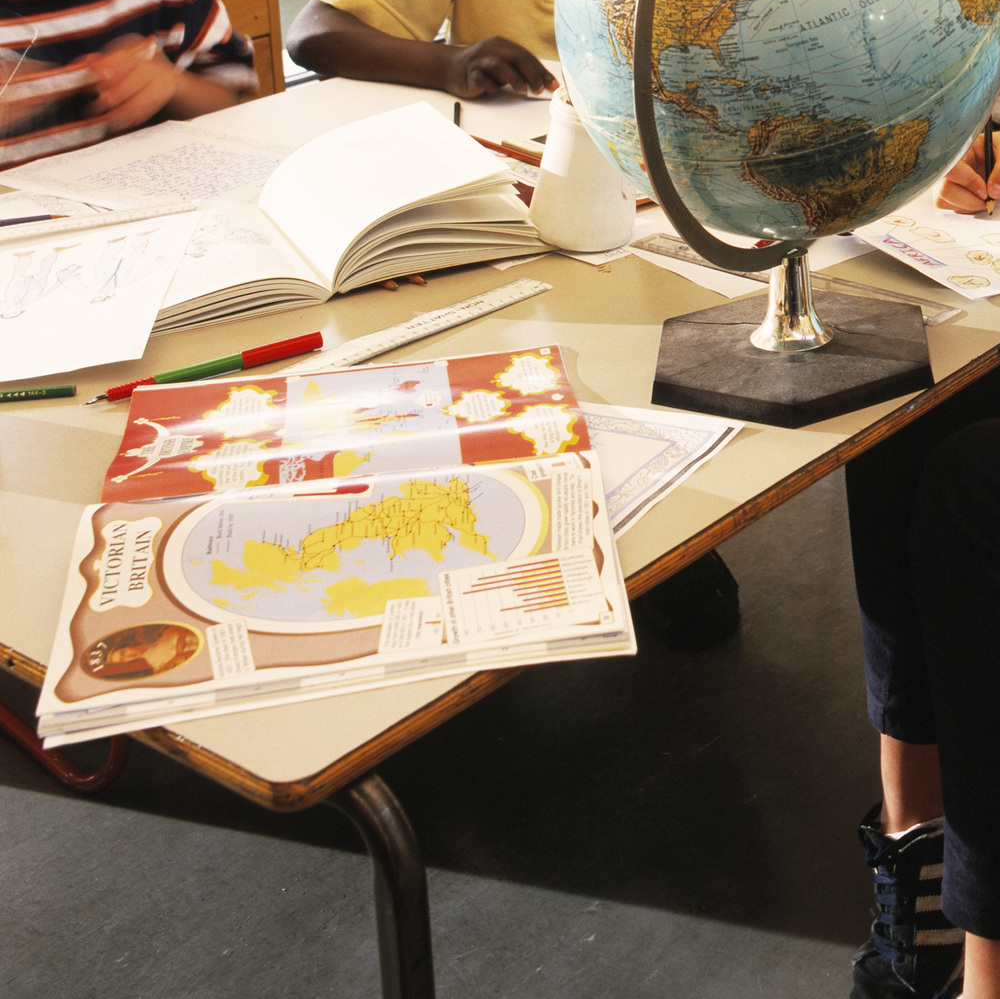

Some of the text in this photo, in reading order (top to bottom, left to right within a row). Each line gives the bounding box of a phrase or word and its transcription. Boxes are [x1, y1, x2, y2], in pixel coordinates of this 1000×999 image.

[800, 7, 850, 32] ATLANTIC
[883, 236, 941, 268] AFRICA
[100, 523, 128, 606] VICTORIAN
[128, 530, 152, 592] BRITAIN
[88, 641, 108, 673] 1837
